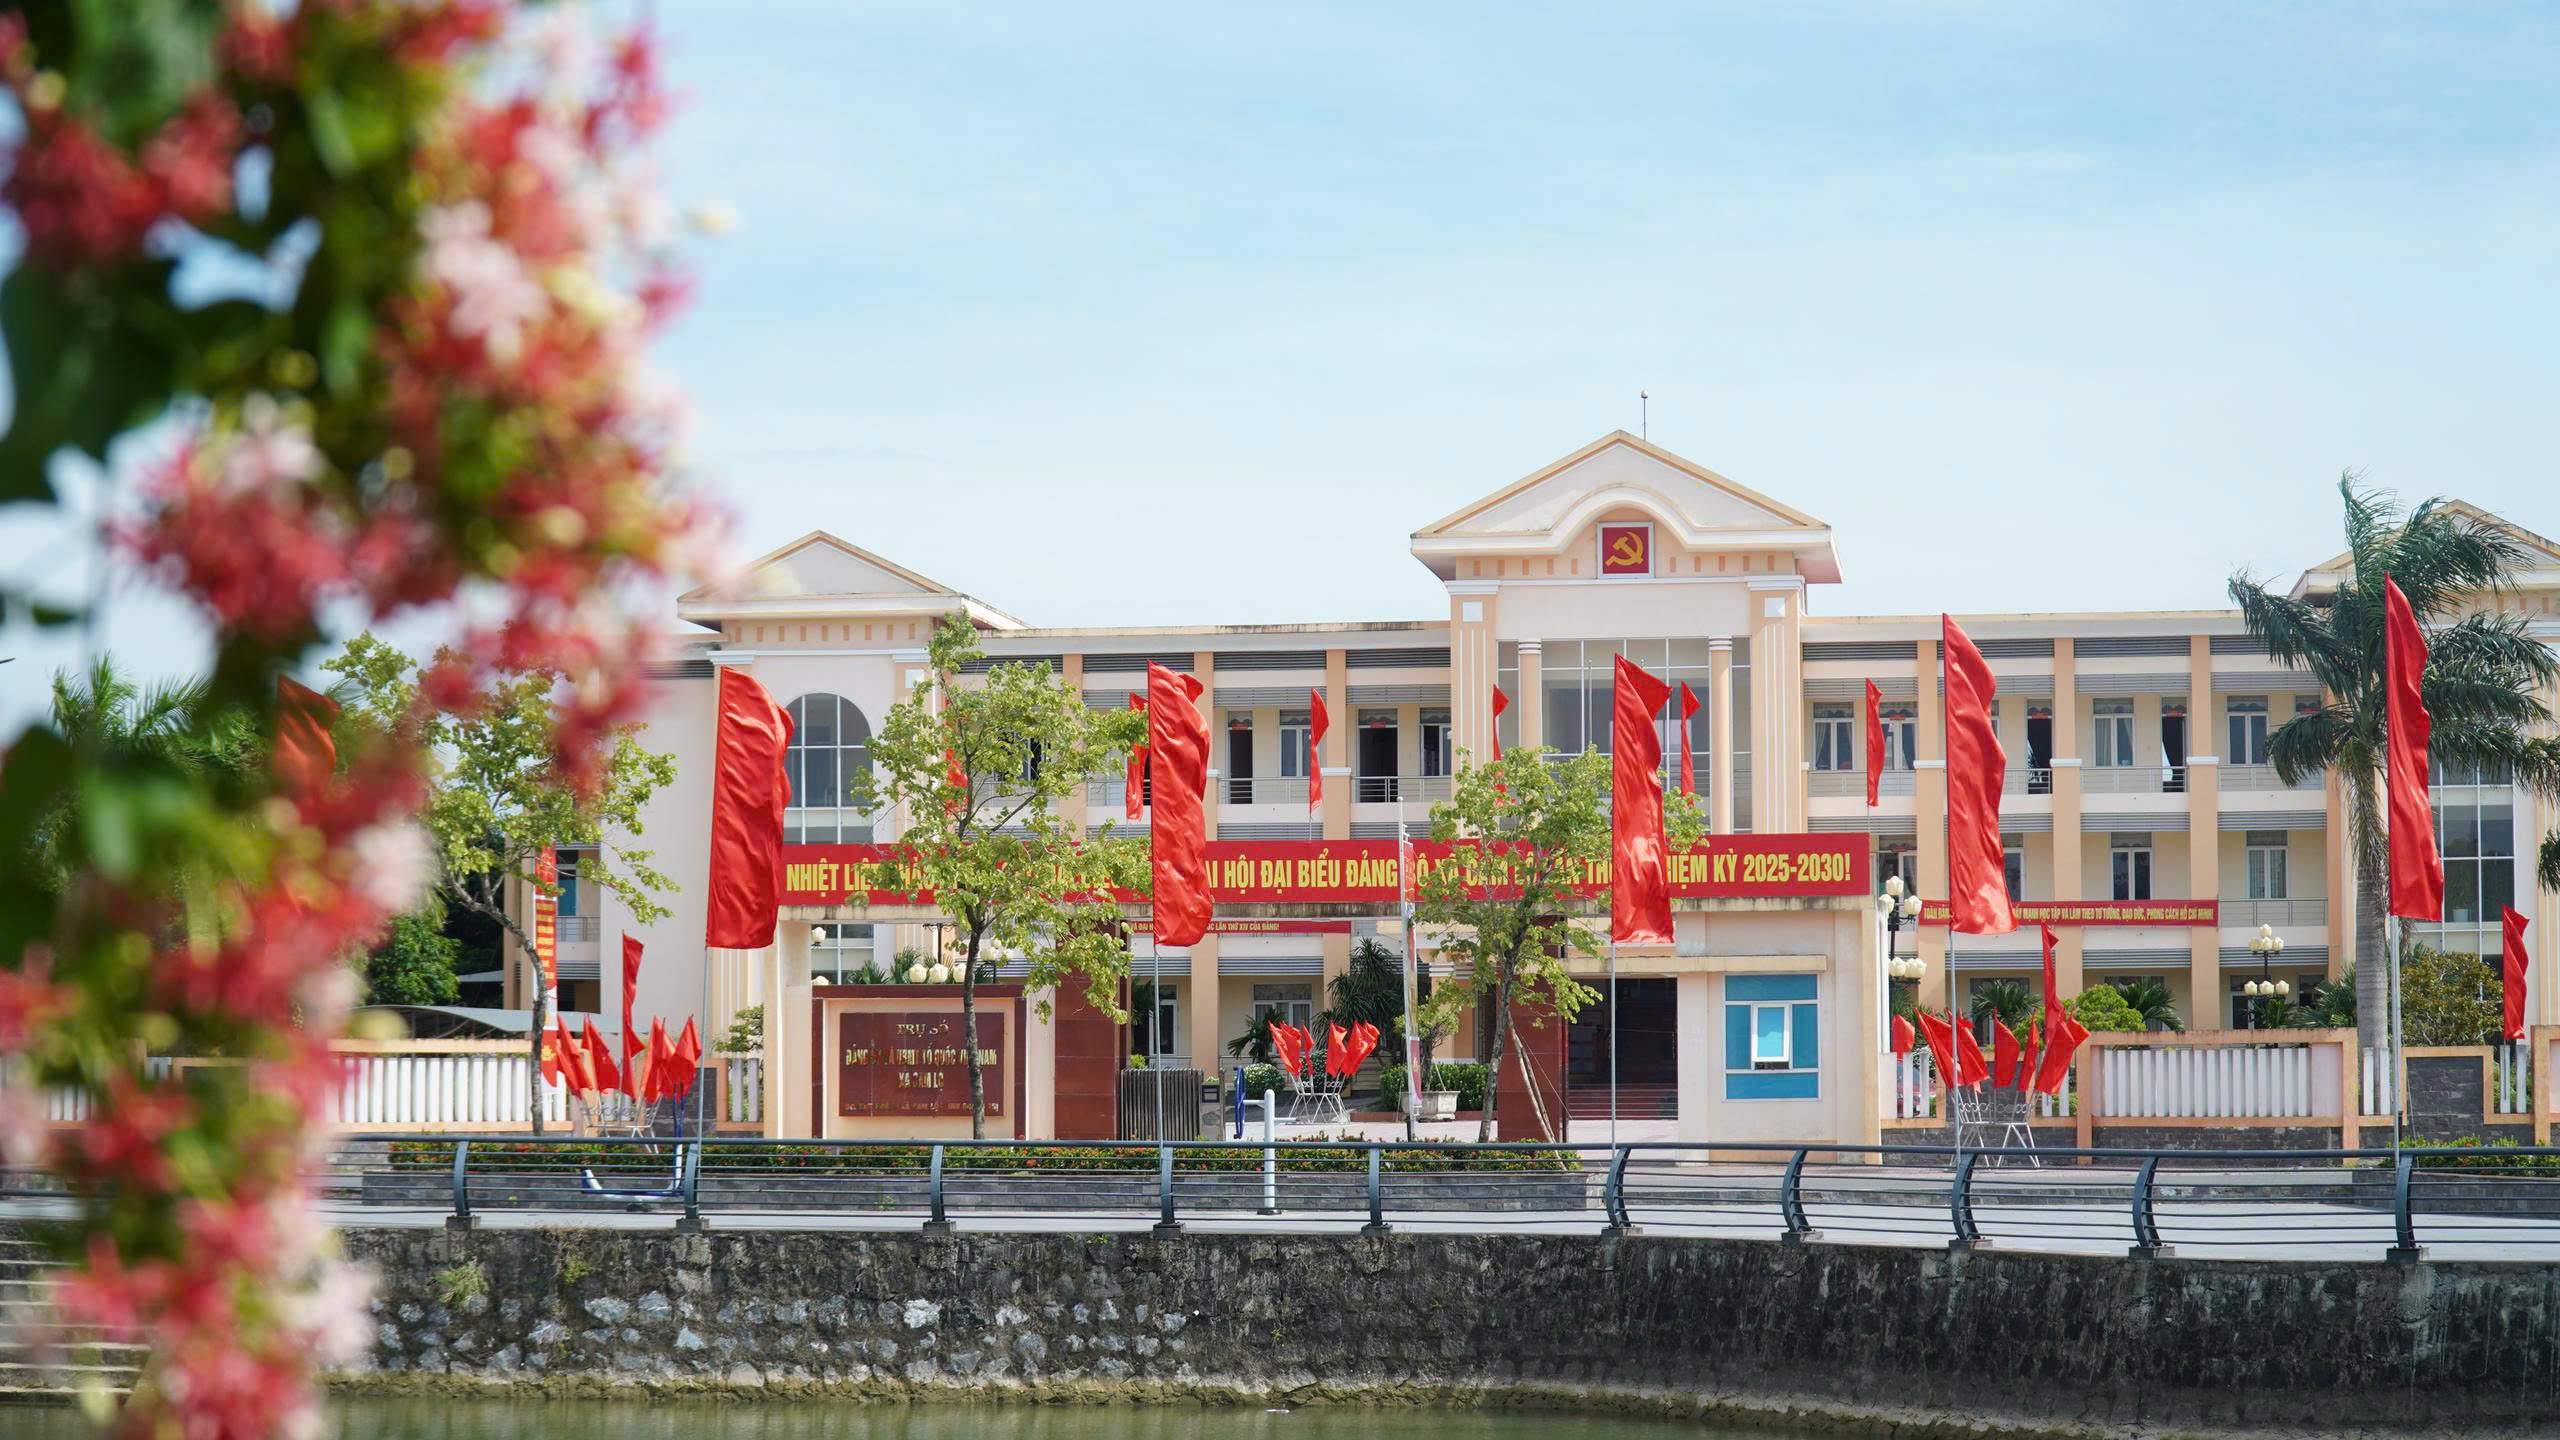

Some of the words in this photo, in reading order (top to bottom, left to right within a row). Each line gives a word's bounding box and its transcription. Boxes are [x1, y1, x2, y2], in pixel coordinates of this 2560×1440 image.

[786, 858, 839, 897] NHIỆT
[1224, 853, 1255, 894] HỘI
[1261, 859, 1292, 894] ĐẠI
[1298, 848, 1340, 888] BIỂU
[1346, 849, 1398, 888] ĐẢNG
[1713, 847, 1738, 883] KỲ
[1743, 851, 1851, 883] 2025-2030!
